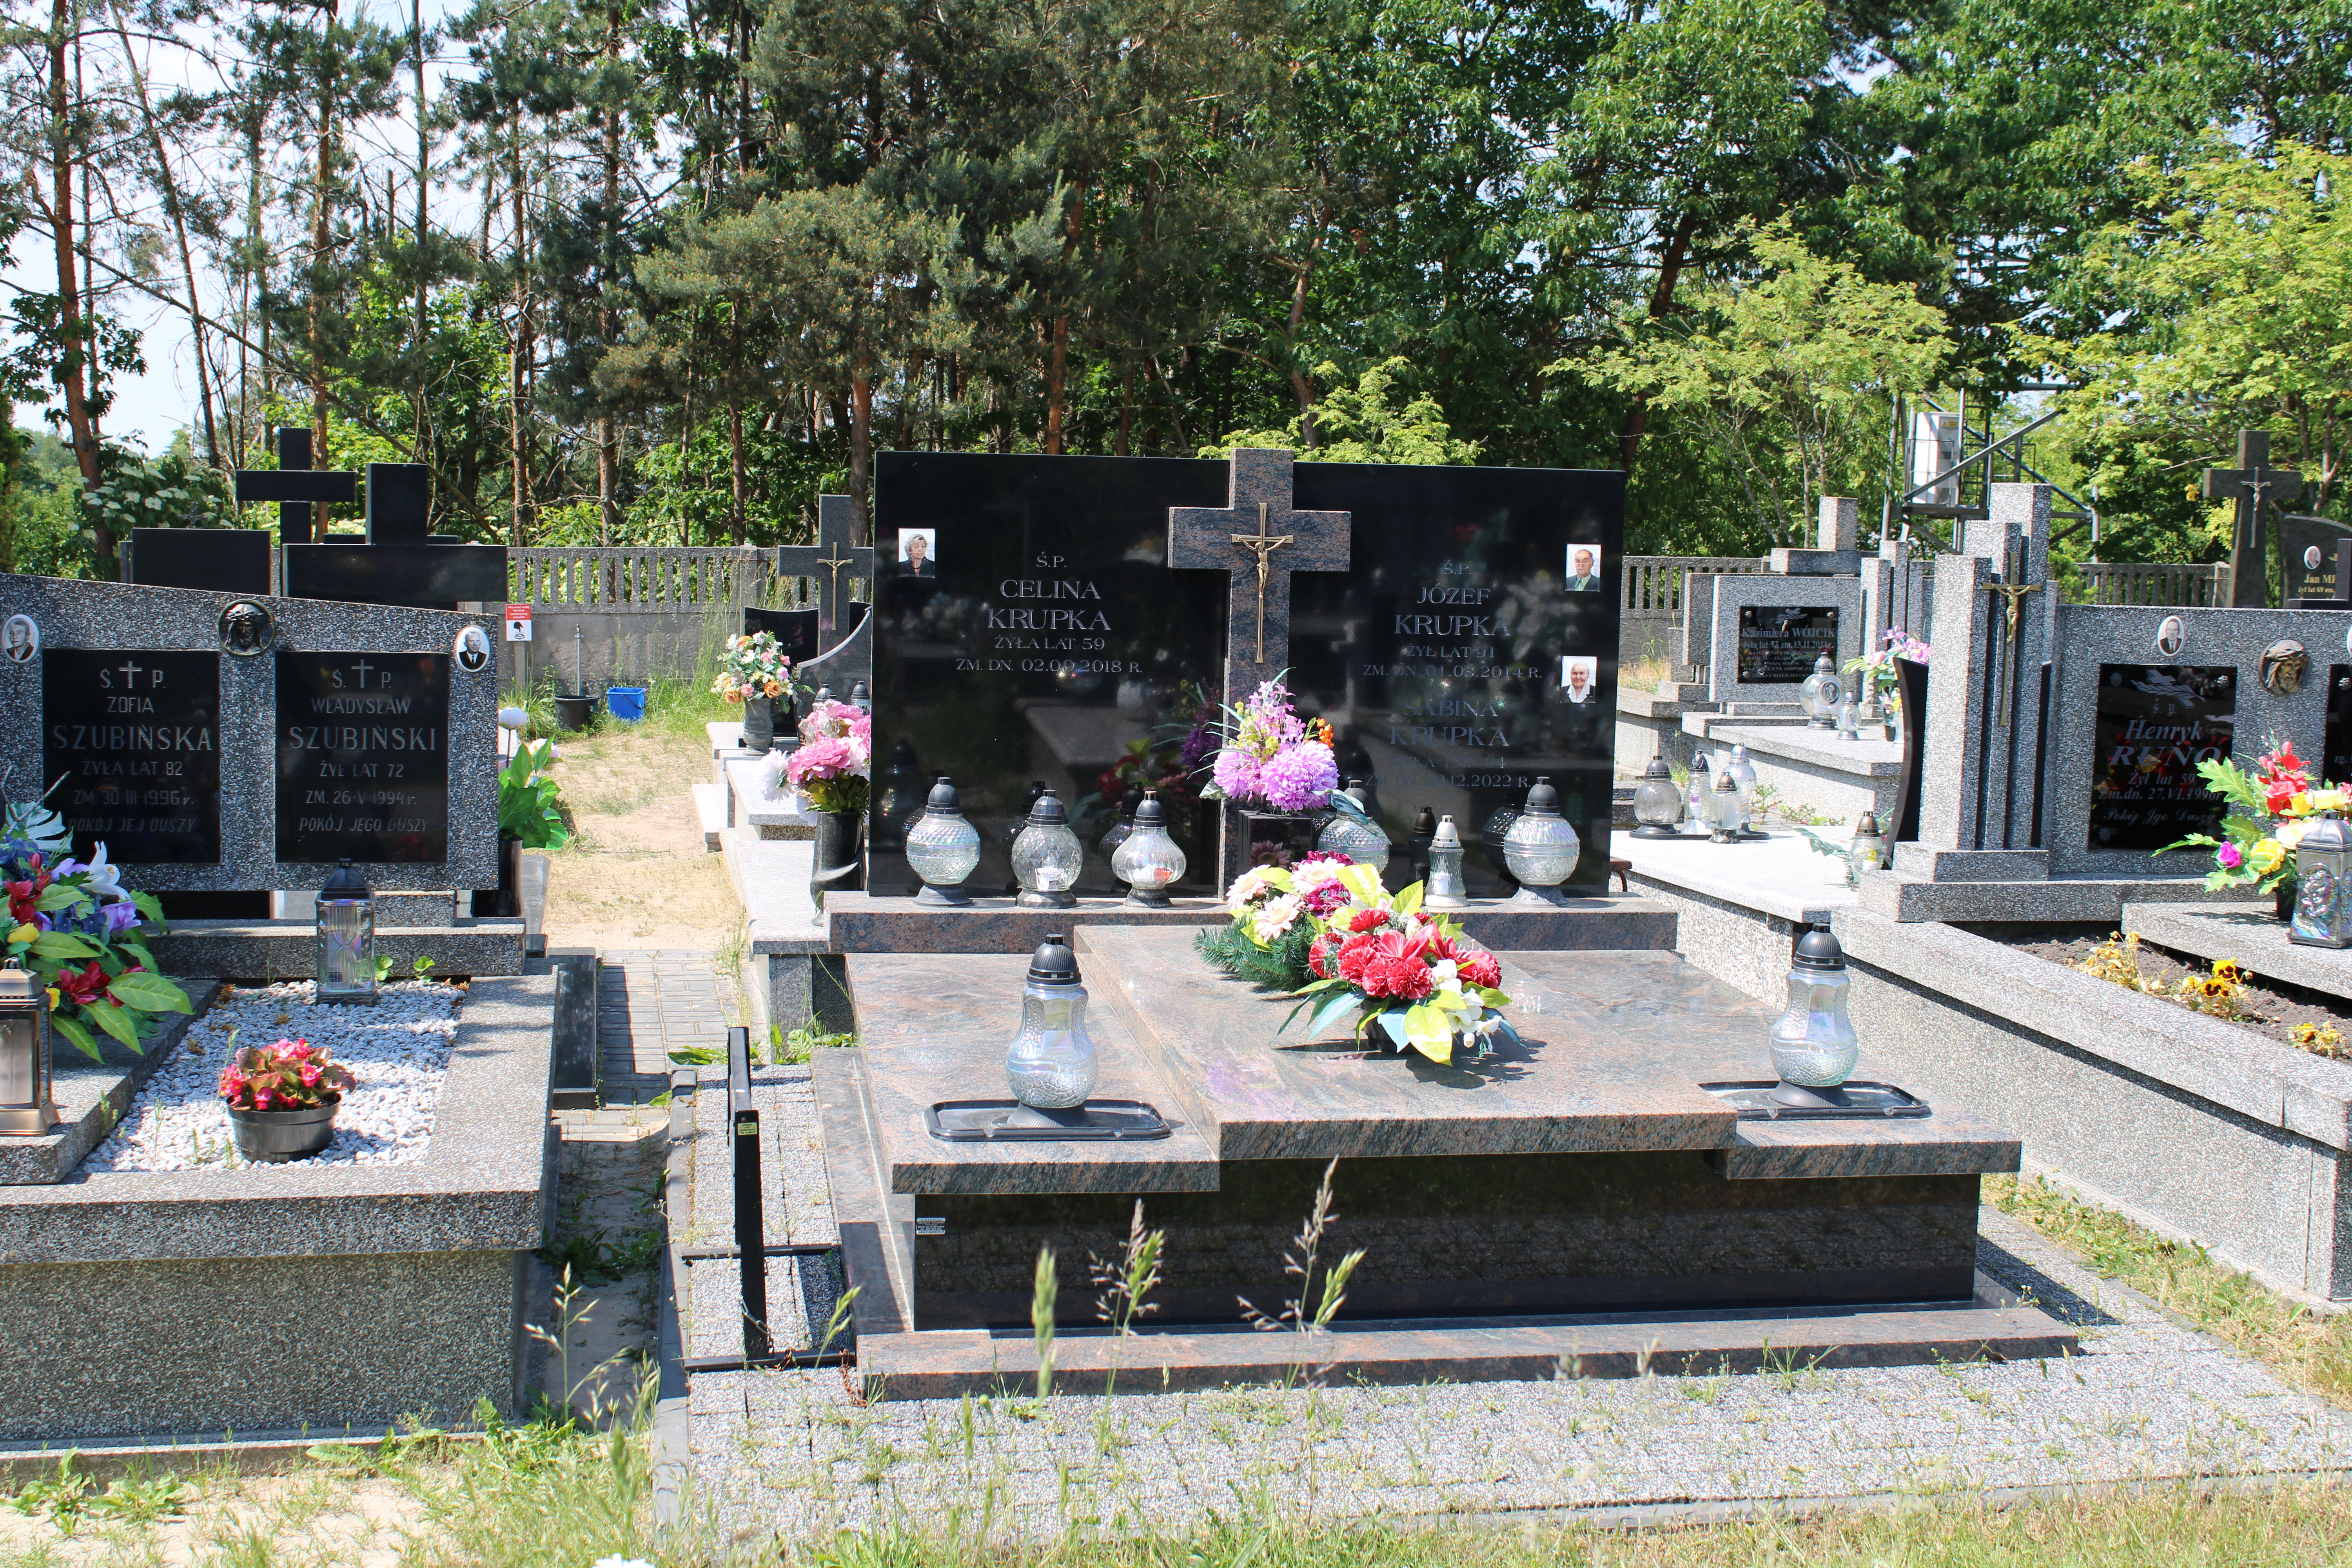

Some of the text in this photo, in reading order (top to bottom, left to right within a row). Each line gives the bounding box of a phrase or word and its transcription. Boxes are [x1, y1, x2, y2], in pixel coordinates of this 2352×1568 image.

[1036, 551, 1067, 567] Ś.P.
[2304, 574, 2320, 583] Jan
[1000, 579, 1101, 599] CELINA
[1417, 583, 1491, 604] JÓZEF
[987, 608, 1112, 630] KRUPKA
[1395, 615, 1511, 636] KRUPKA
[1742, 625, 1835, 637] Kazimiera WÓJCIK
[995, 635, 1105, 650] ŻYŁA LAT 59
[1406, 643, 1494, 658] ŻYŁ LAT 91
[956, 659, 982, 670] ZM.
[989, 659, 1013, 671] DN.
[1129, 662, 1142, 673] R.
[1363, 665, 1388, 675] ZM.
[1425, 665, 1523, 678] 01.08.2014
[1528, 667, 1542, 678] R.
[381, 671, 391, 688] P.
[106, 697, 154, 713] ZOFIA
[311, 697, 411, 714] WŁADYSŁAW
[1403, 699, 1498, 717] SABINA
[53, 724, 213, 750] SZUBIŃSKA
[289, 724, 436, 750] SZUBIŃSKI
[1390, 727, 1509, 746] KRUPKA
[2124, 720, 2203, 745] Henryk
[1392, 754, 1505, 768] ŻYŁA LAT 94
[2109, 746, 2221, 766] RUNO
[82, 758, 183, 775] ŻYŁA LAT 82
[319, 760, 404, 777] ŻYŁ LAT 72
[1518, 777, 1531, 787] R.
[2156, 773, 2173, 784] lat
[2180, 773, 2195, 784] 59
[73, 789, 97, 804] ZM.
[305, 790, 329, 804] ZM.
[67, 816, 196, 832] POKÓJ JEJ DUSZY
[298, 815, 428, 832] POKÓJ JEGO DUSZY
[2103, 808, 2140, 826] Pokój
[2176, 808, 2216, 826] Duszy
